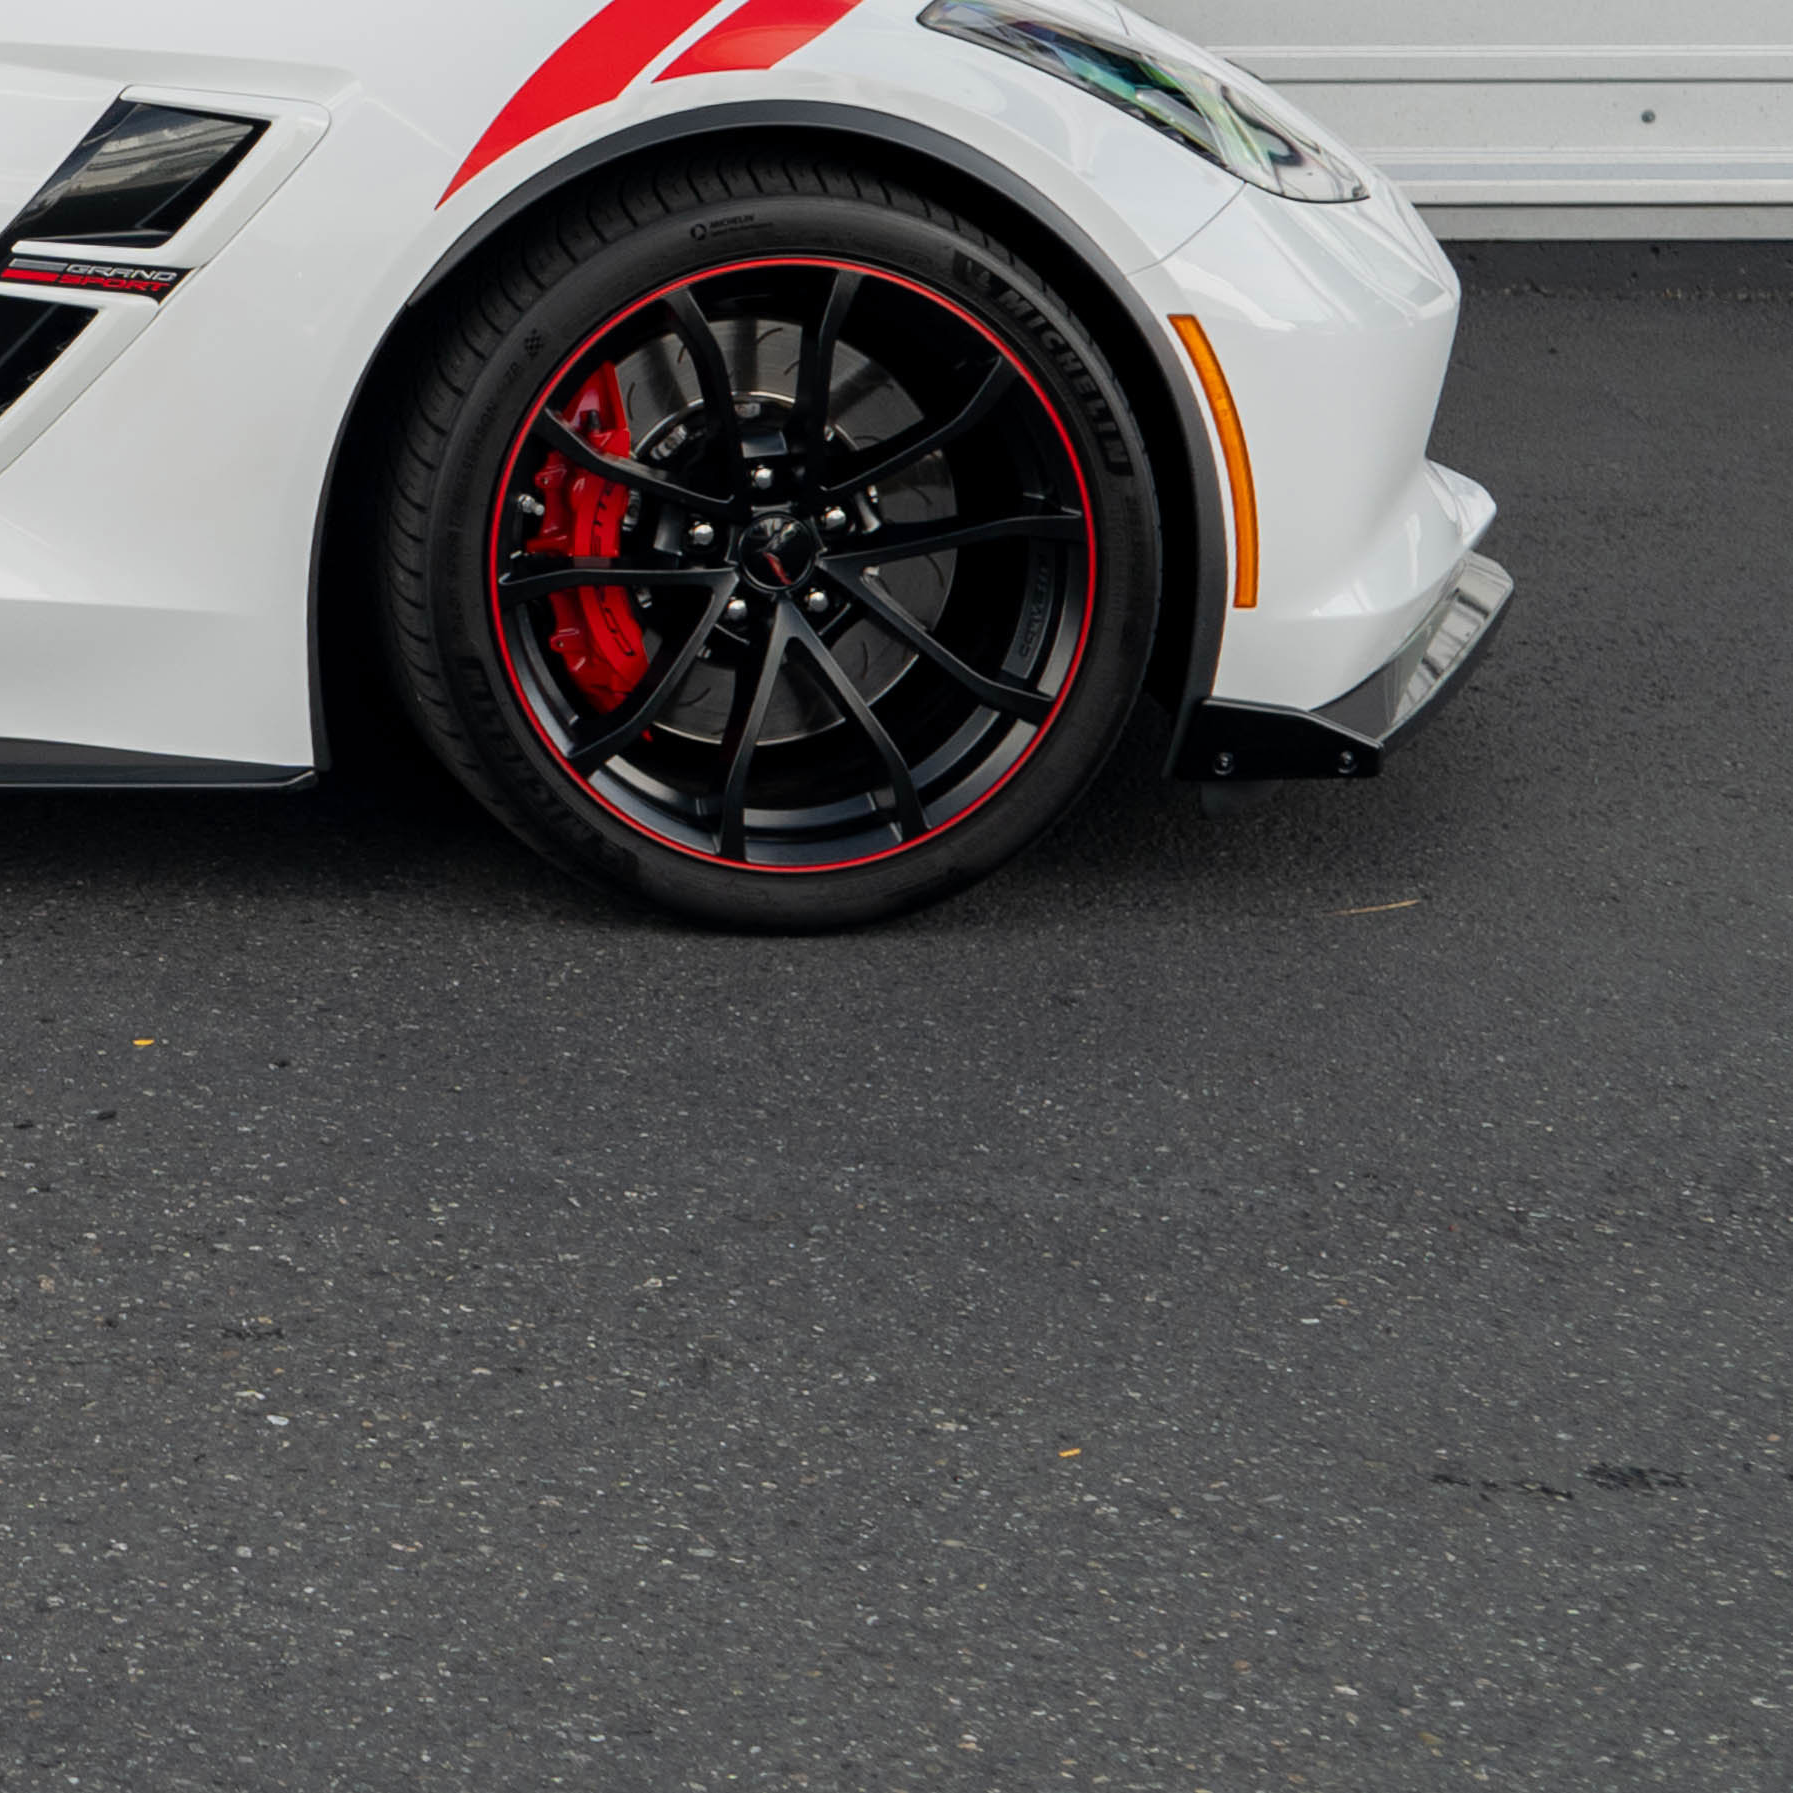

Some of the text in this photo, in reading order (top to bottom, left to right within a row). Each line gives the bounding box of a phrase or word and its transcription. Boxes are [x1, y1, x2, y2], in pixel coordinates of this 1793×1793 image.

[66, 264, 177, 282] GRAND
[59, 274, 171, 292] SPORT
[998, 289, 1129, 463] MICHELIN
